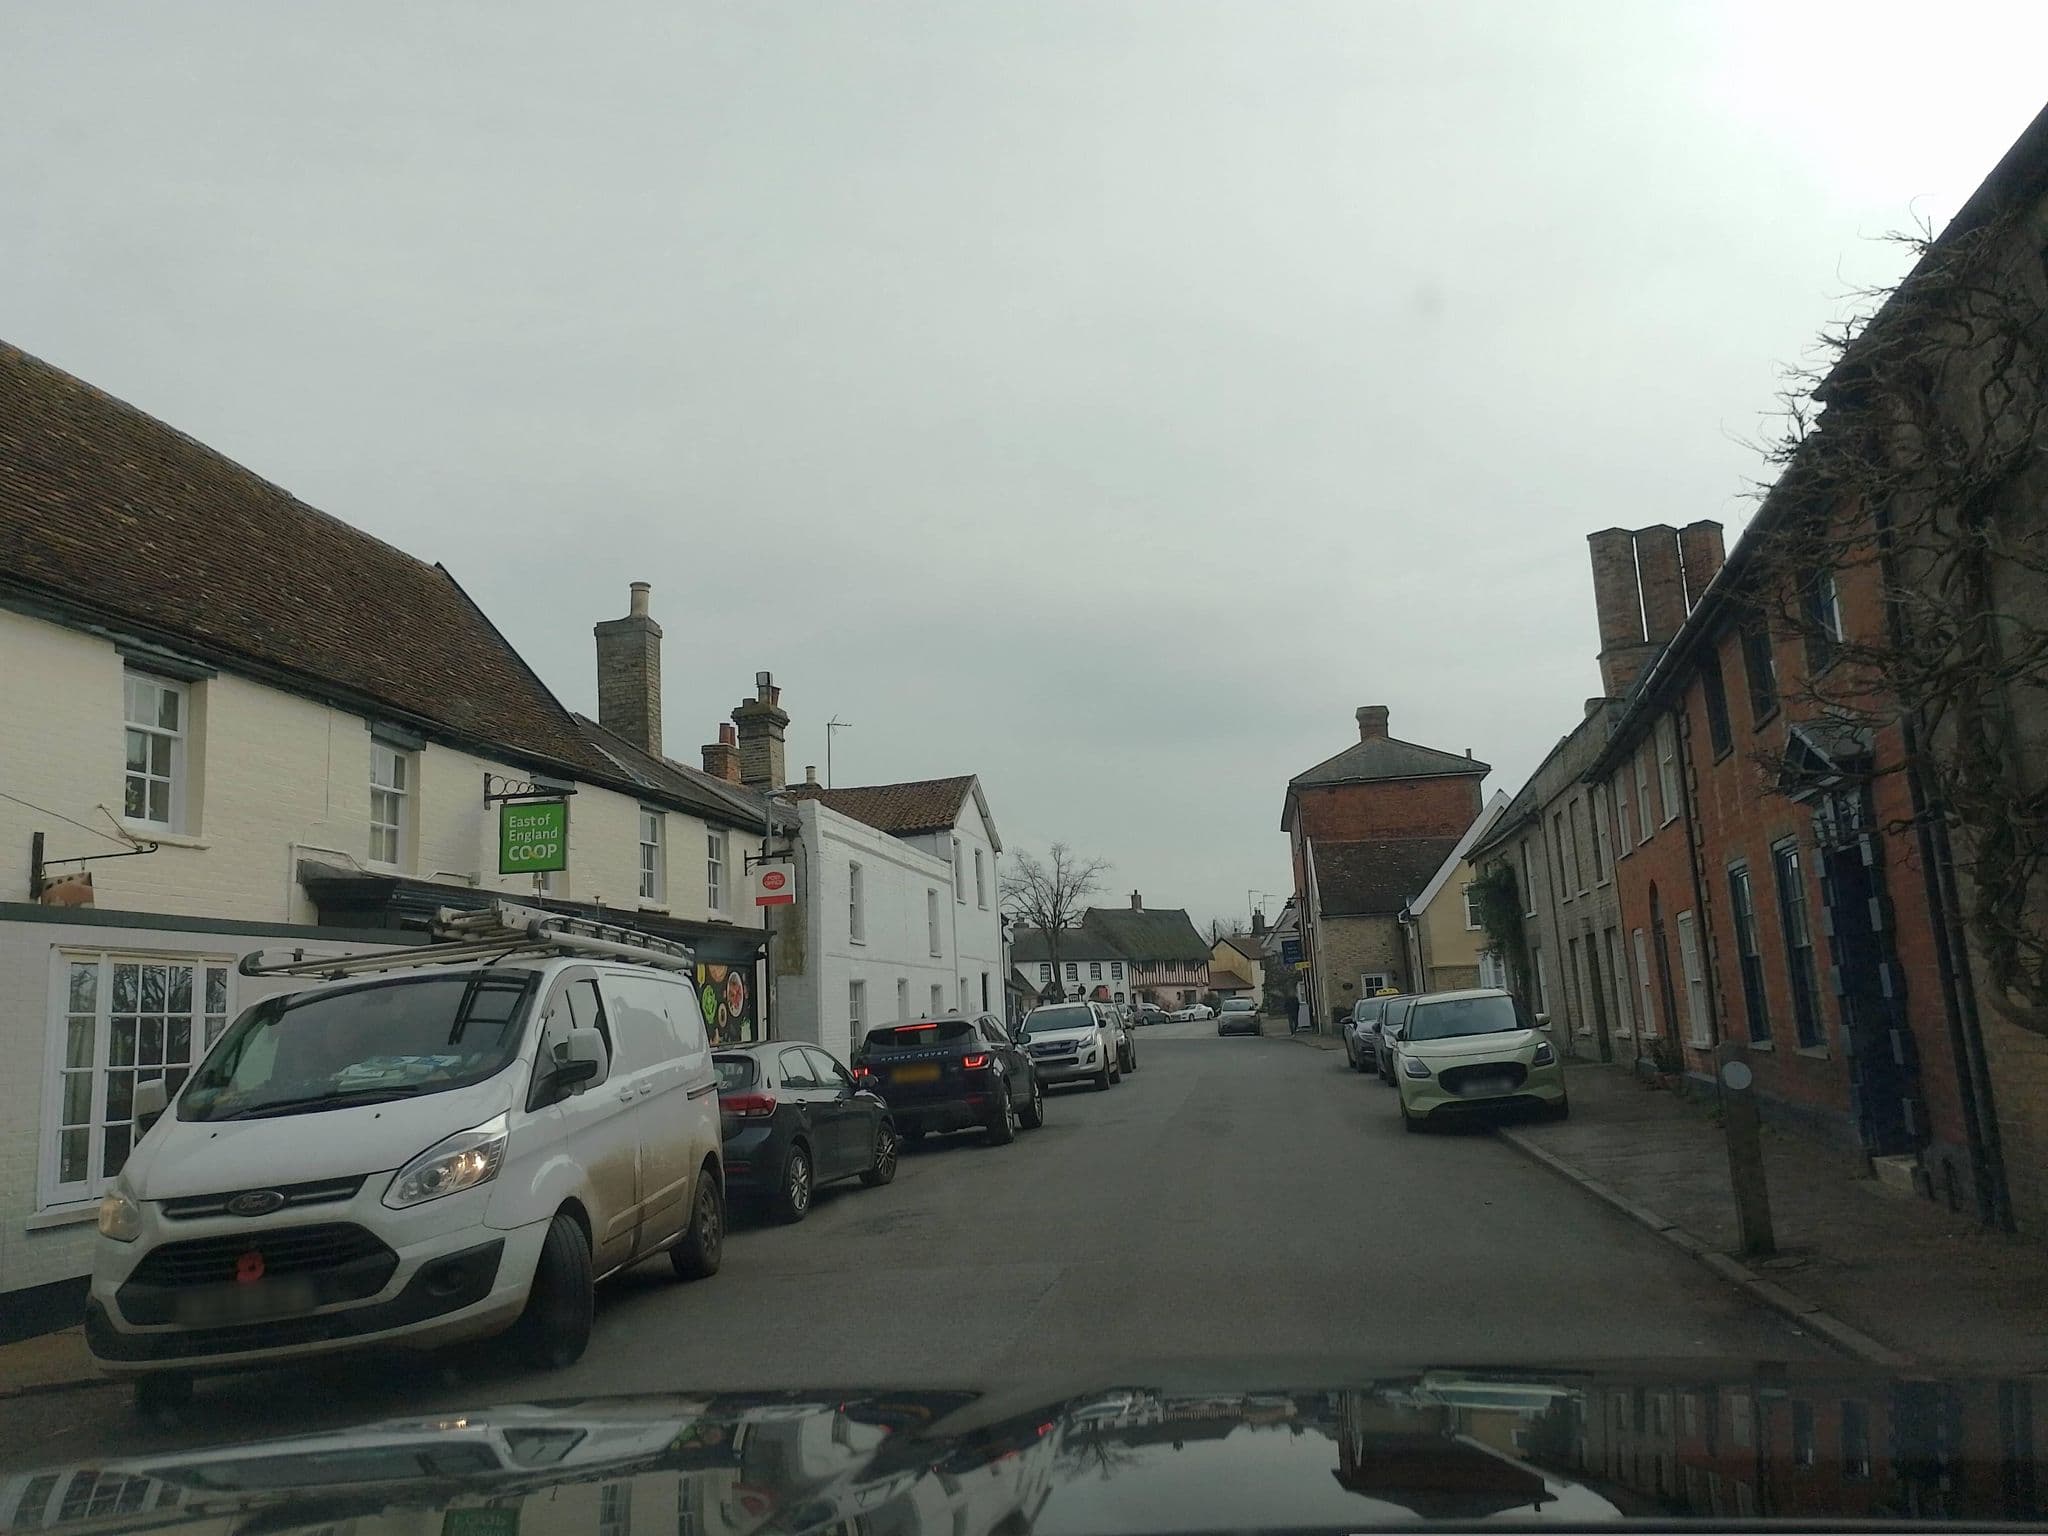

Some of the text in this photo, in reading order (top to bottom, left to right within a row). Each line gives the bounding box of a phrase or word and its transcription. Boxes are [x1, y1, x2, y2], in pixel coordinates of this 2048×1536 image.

[509, 813, 551, 828] East of
[509, 826, 558, 843] England
[239, 1194, 266, 1209] Ford
